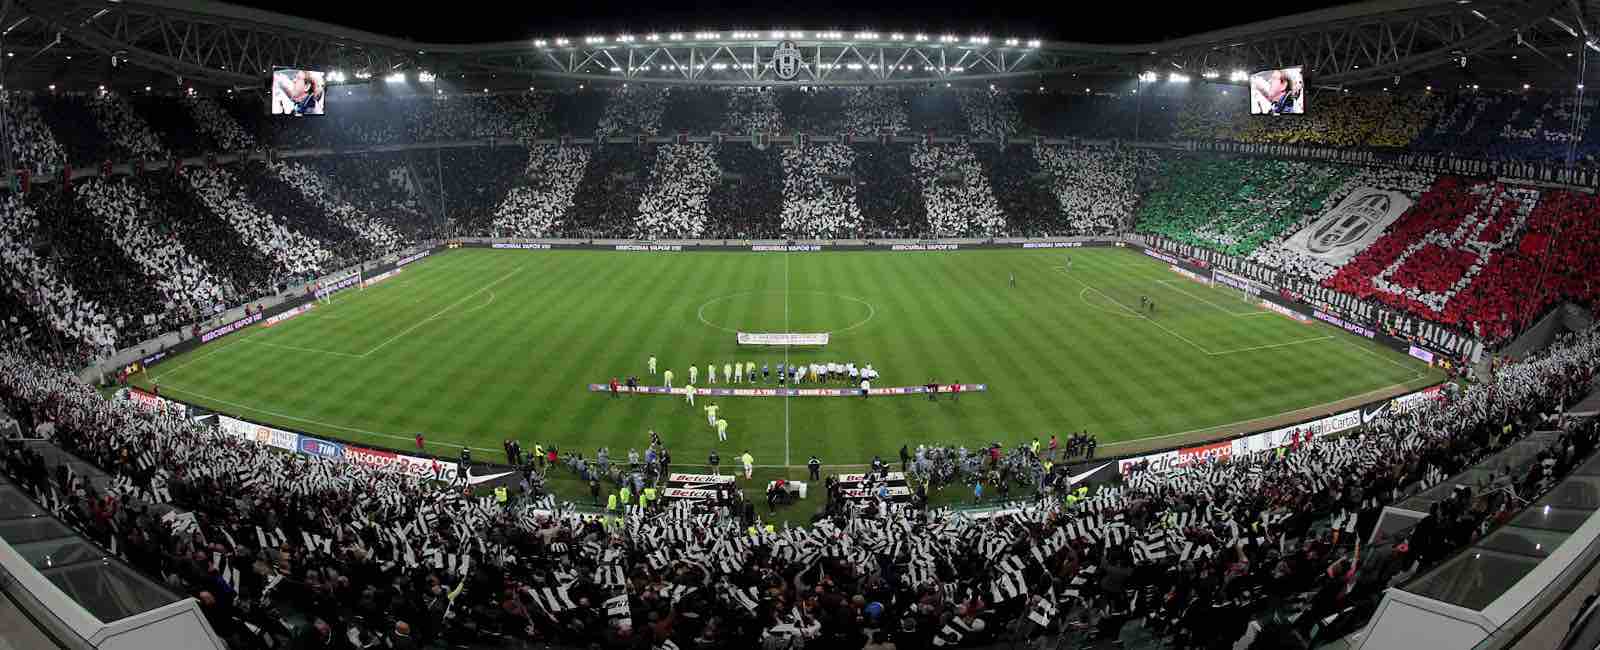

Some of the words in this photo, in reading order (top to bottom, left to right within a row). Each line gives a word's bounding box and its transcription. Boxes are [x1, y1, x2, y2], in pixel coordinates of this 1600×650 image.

[1212, 251, 1238, 274] STATO
[1417, 320, 1473, 358] SALVATO
[234, 317, 252, 331] VAPOR
[1344, 320, 1364, 336] VAPOR
[318, 443, 336, 457] TIM
[1122, 453, 1178, 475] Bclic
[676, 474, 720, 483] Betclic
